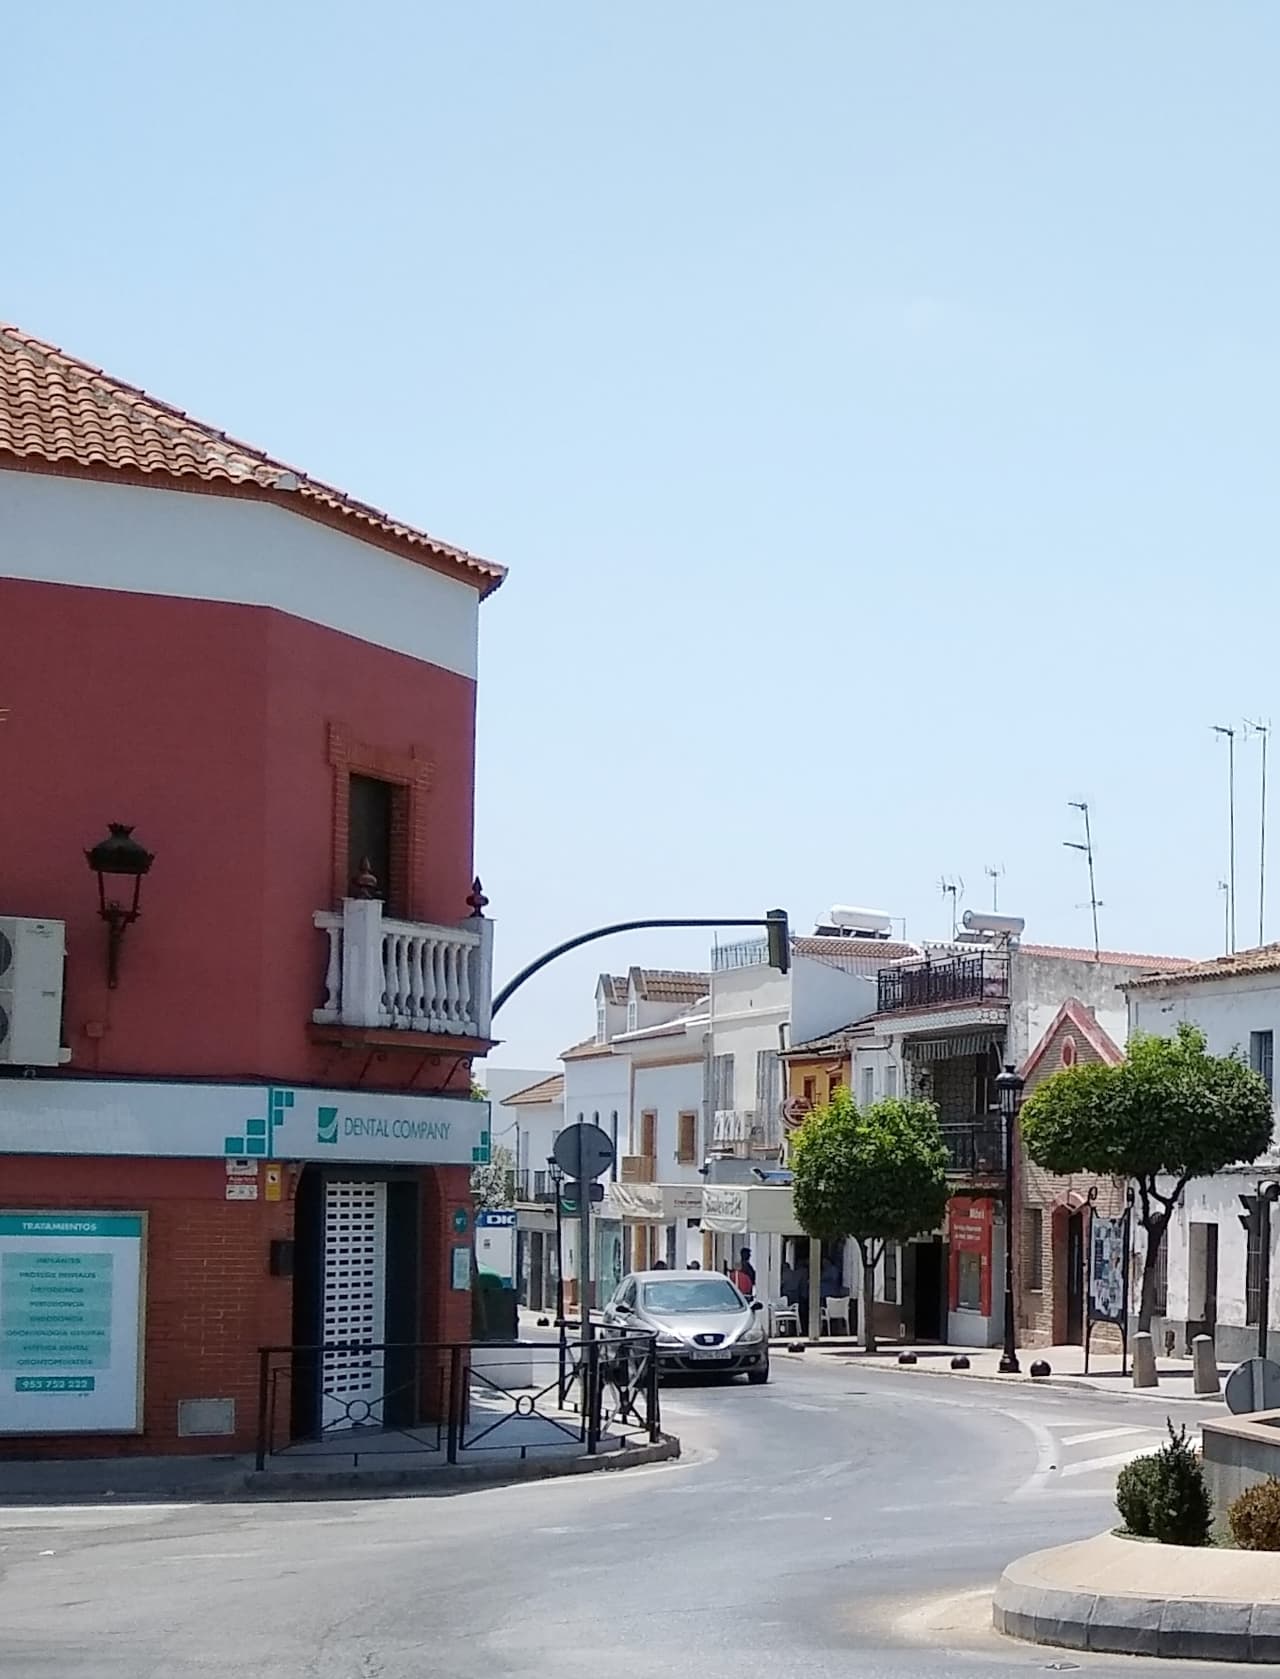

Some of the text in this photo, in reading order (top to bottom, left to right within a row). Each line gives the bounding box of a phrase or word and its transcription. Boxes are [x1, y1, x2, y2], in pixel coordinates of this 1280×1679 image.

[344, 1117, 451, 1140] DENTAL COMPANY
[22, 1222, 97, 1232] TRATAMIENTOS
